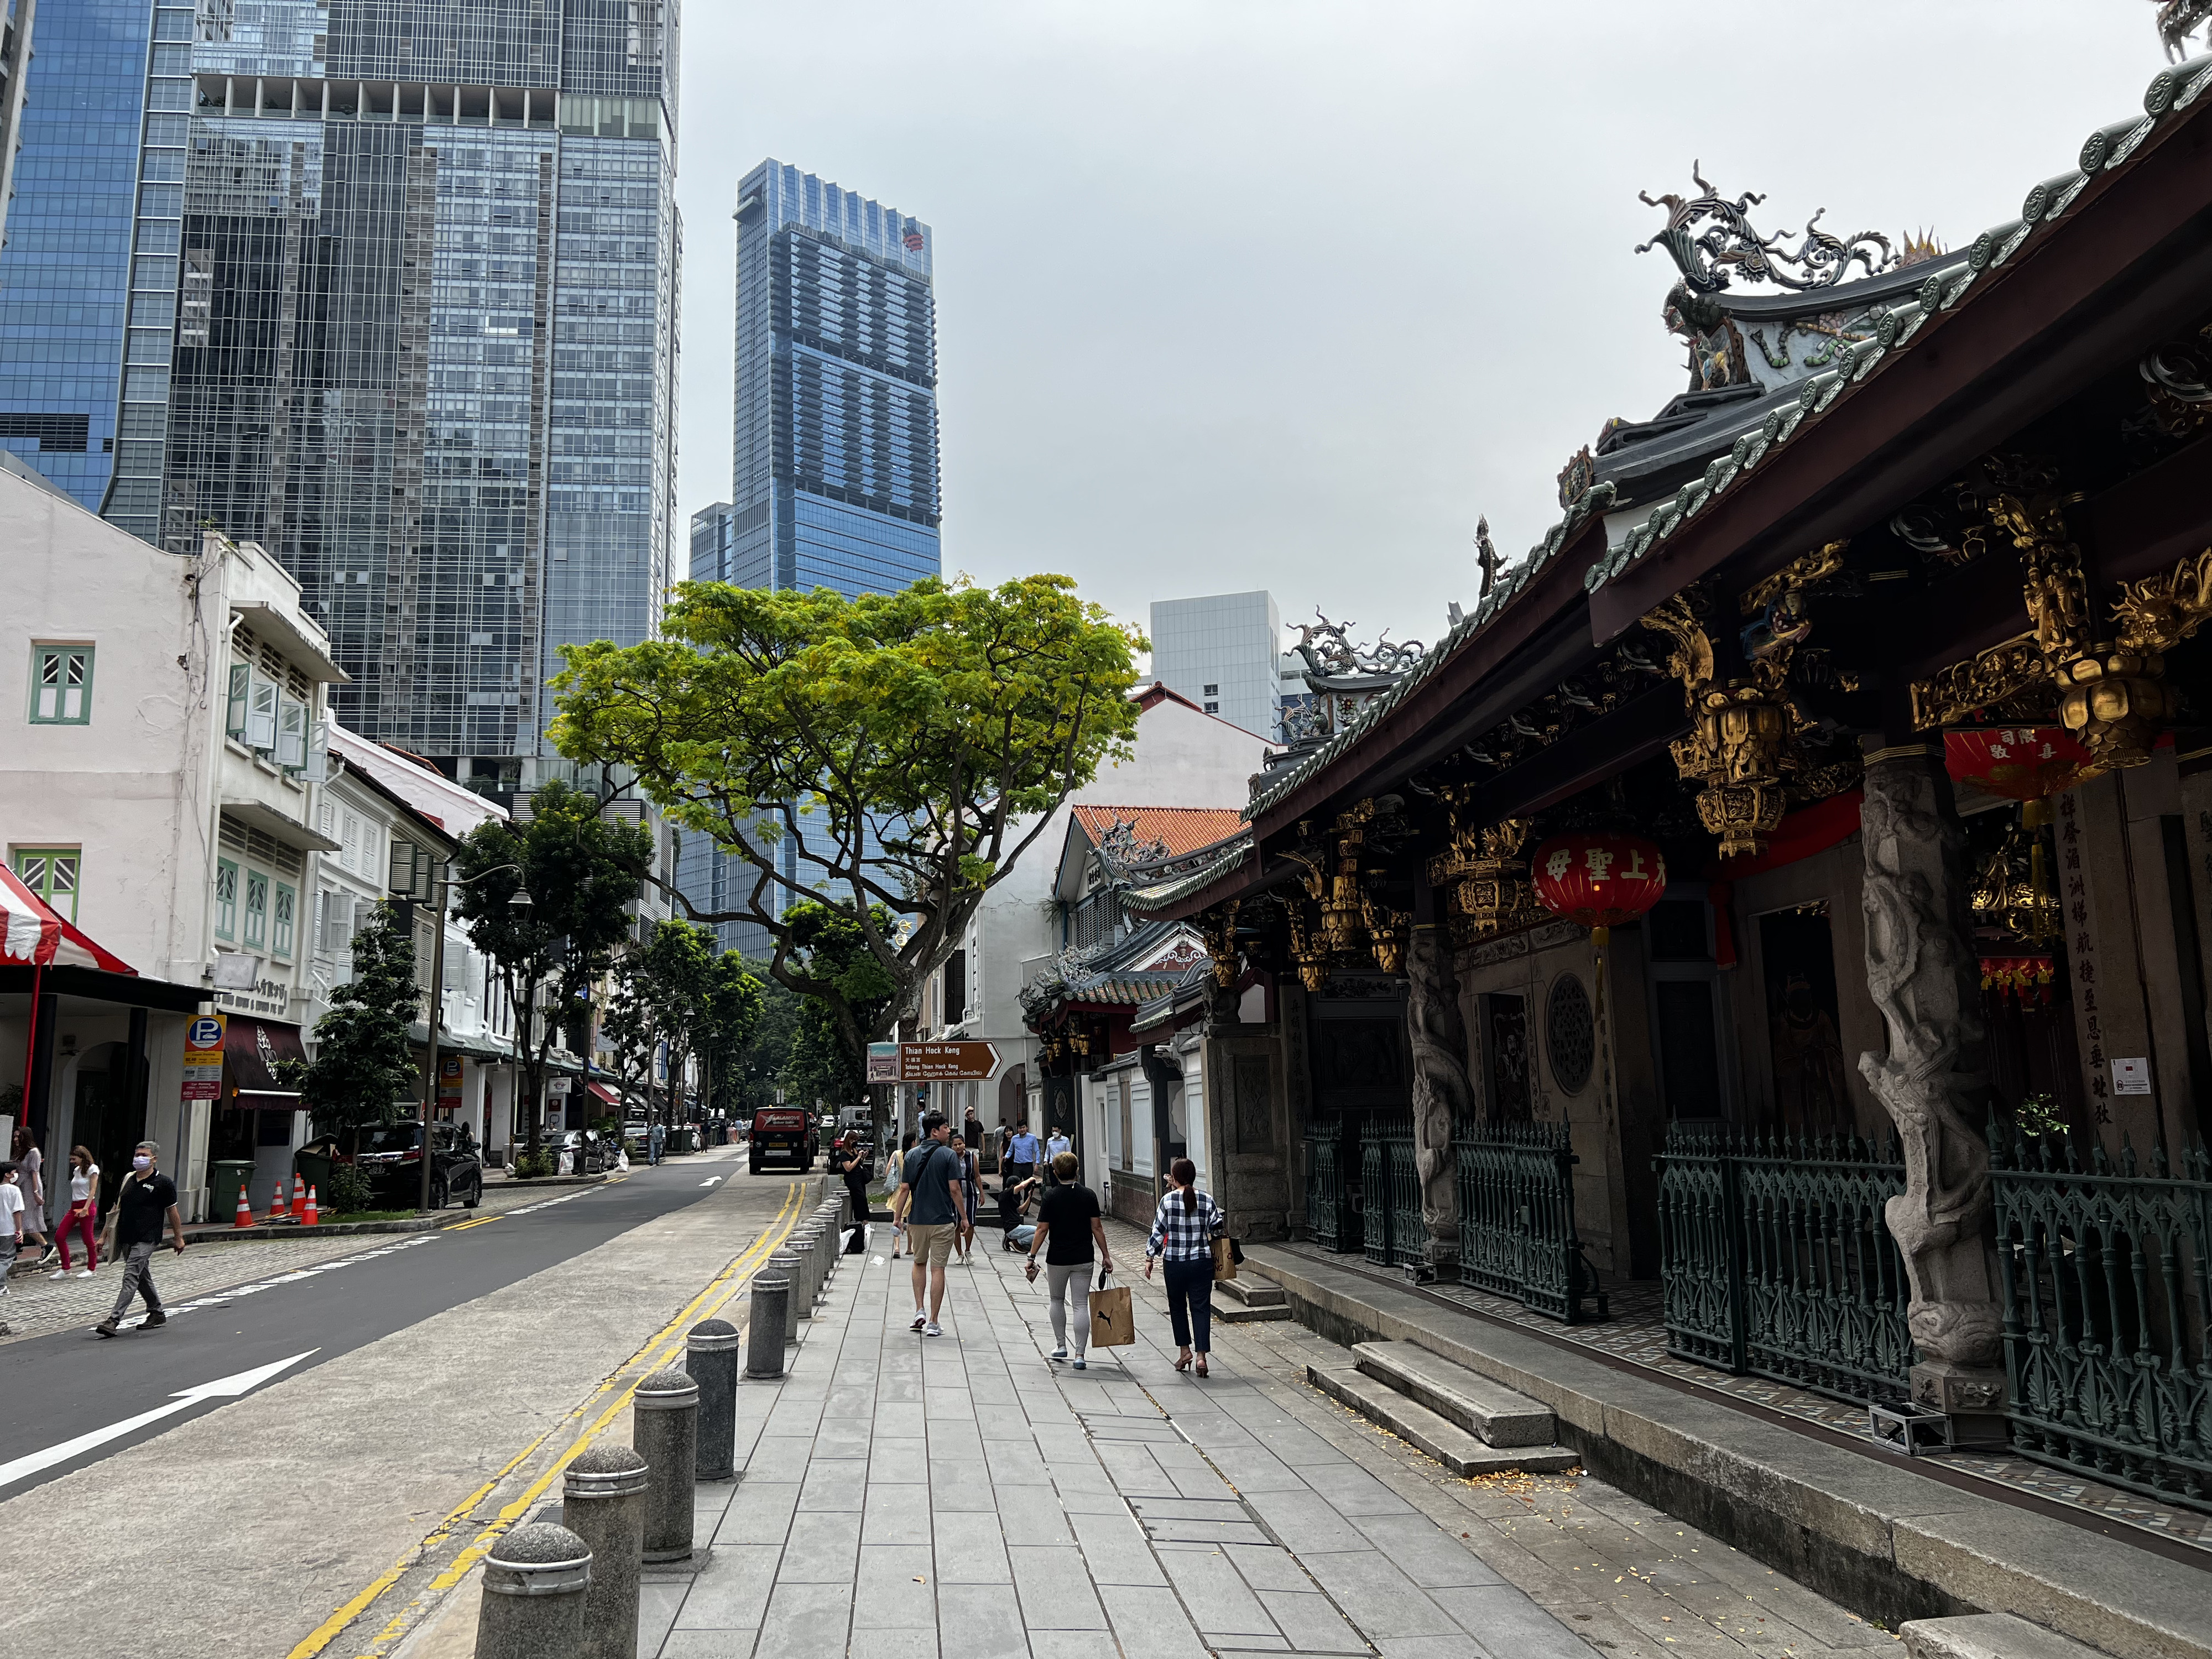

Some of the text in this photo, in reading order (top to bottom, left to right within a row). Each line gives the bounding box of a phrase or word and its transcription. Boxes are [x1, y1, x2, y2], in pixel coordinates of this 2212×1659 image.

[905, 1046, 960, 1056] Thian Hock Keng
